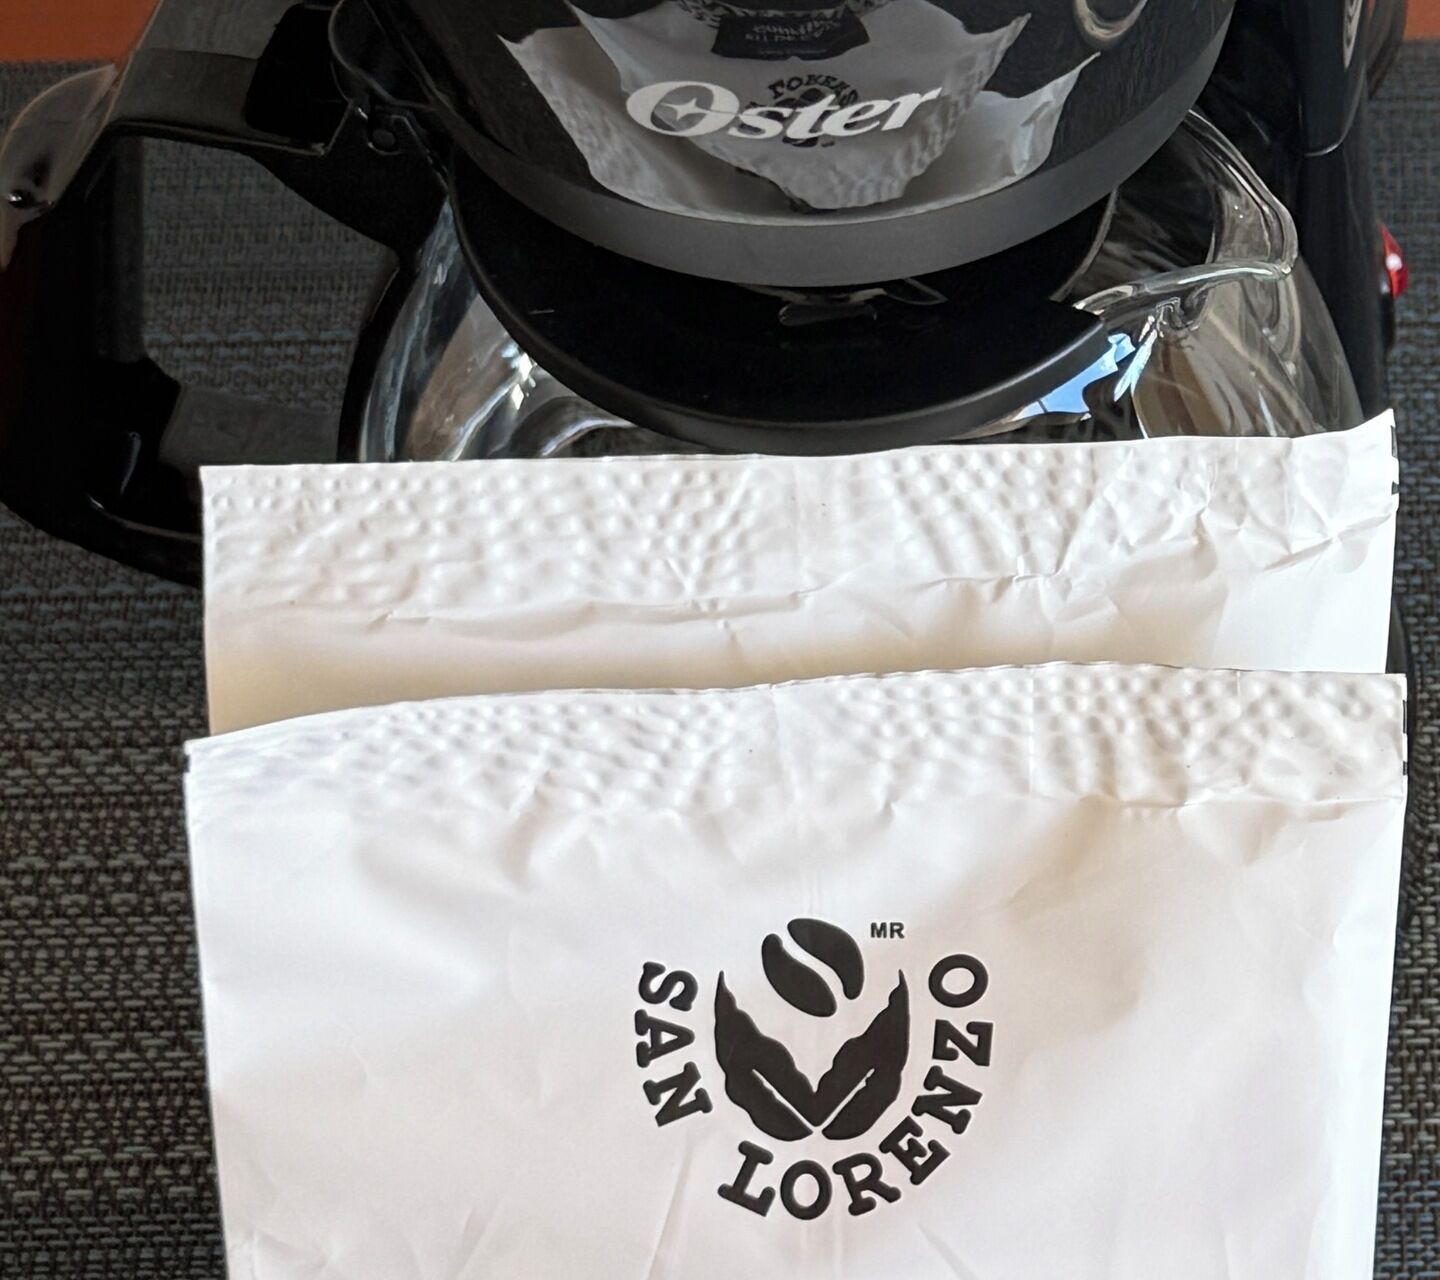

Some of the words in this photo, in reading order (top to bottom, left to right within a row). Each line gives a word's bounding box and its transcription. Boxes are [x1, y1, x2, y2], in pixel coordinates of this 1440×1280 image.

[625, 80, 941, 140] Oster
[870, 922, 905, 939] MR
[634, 961, 713, 1128] SAN
[717, 953, 995, 1221] LORENZO
